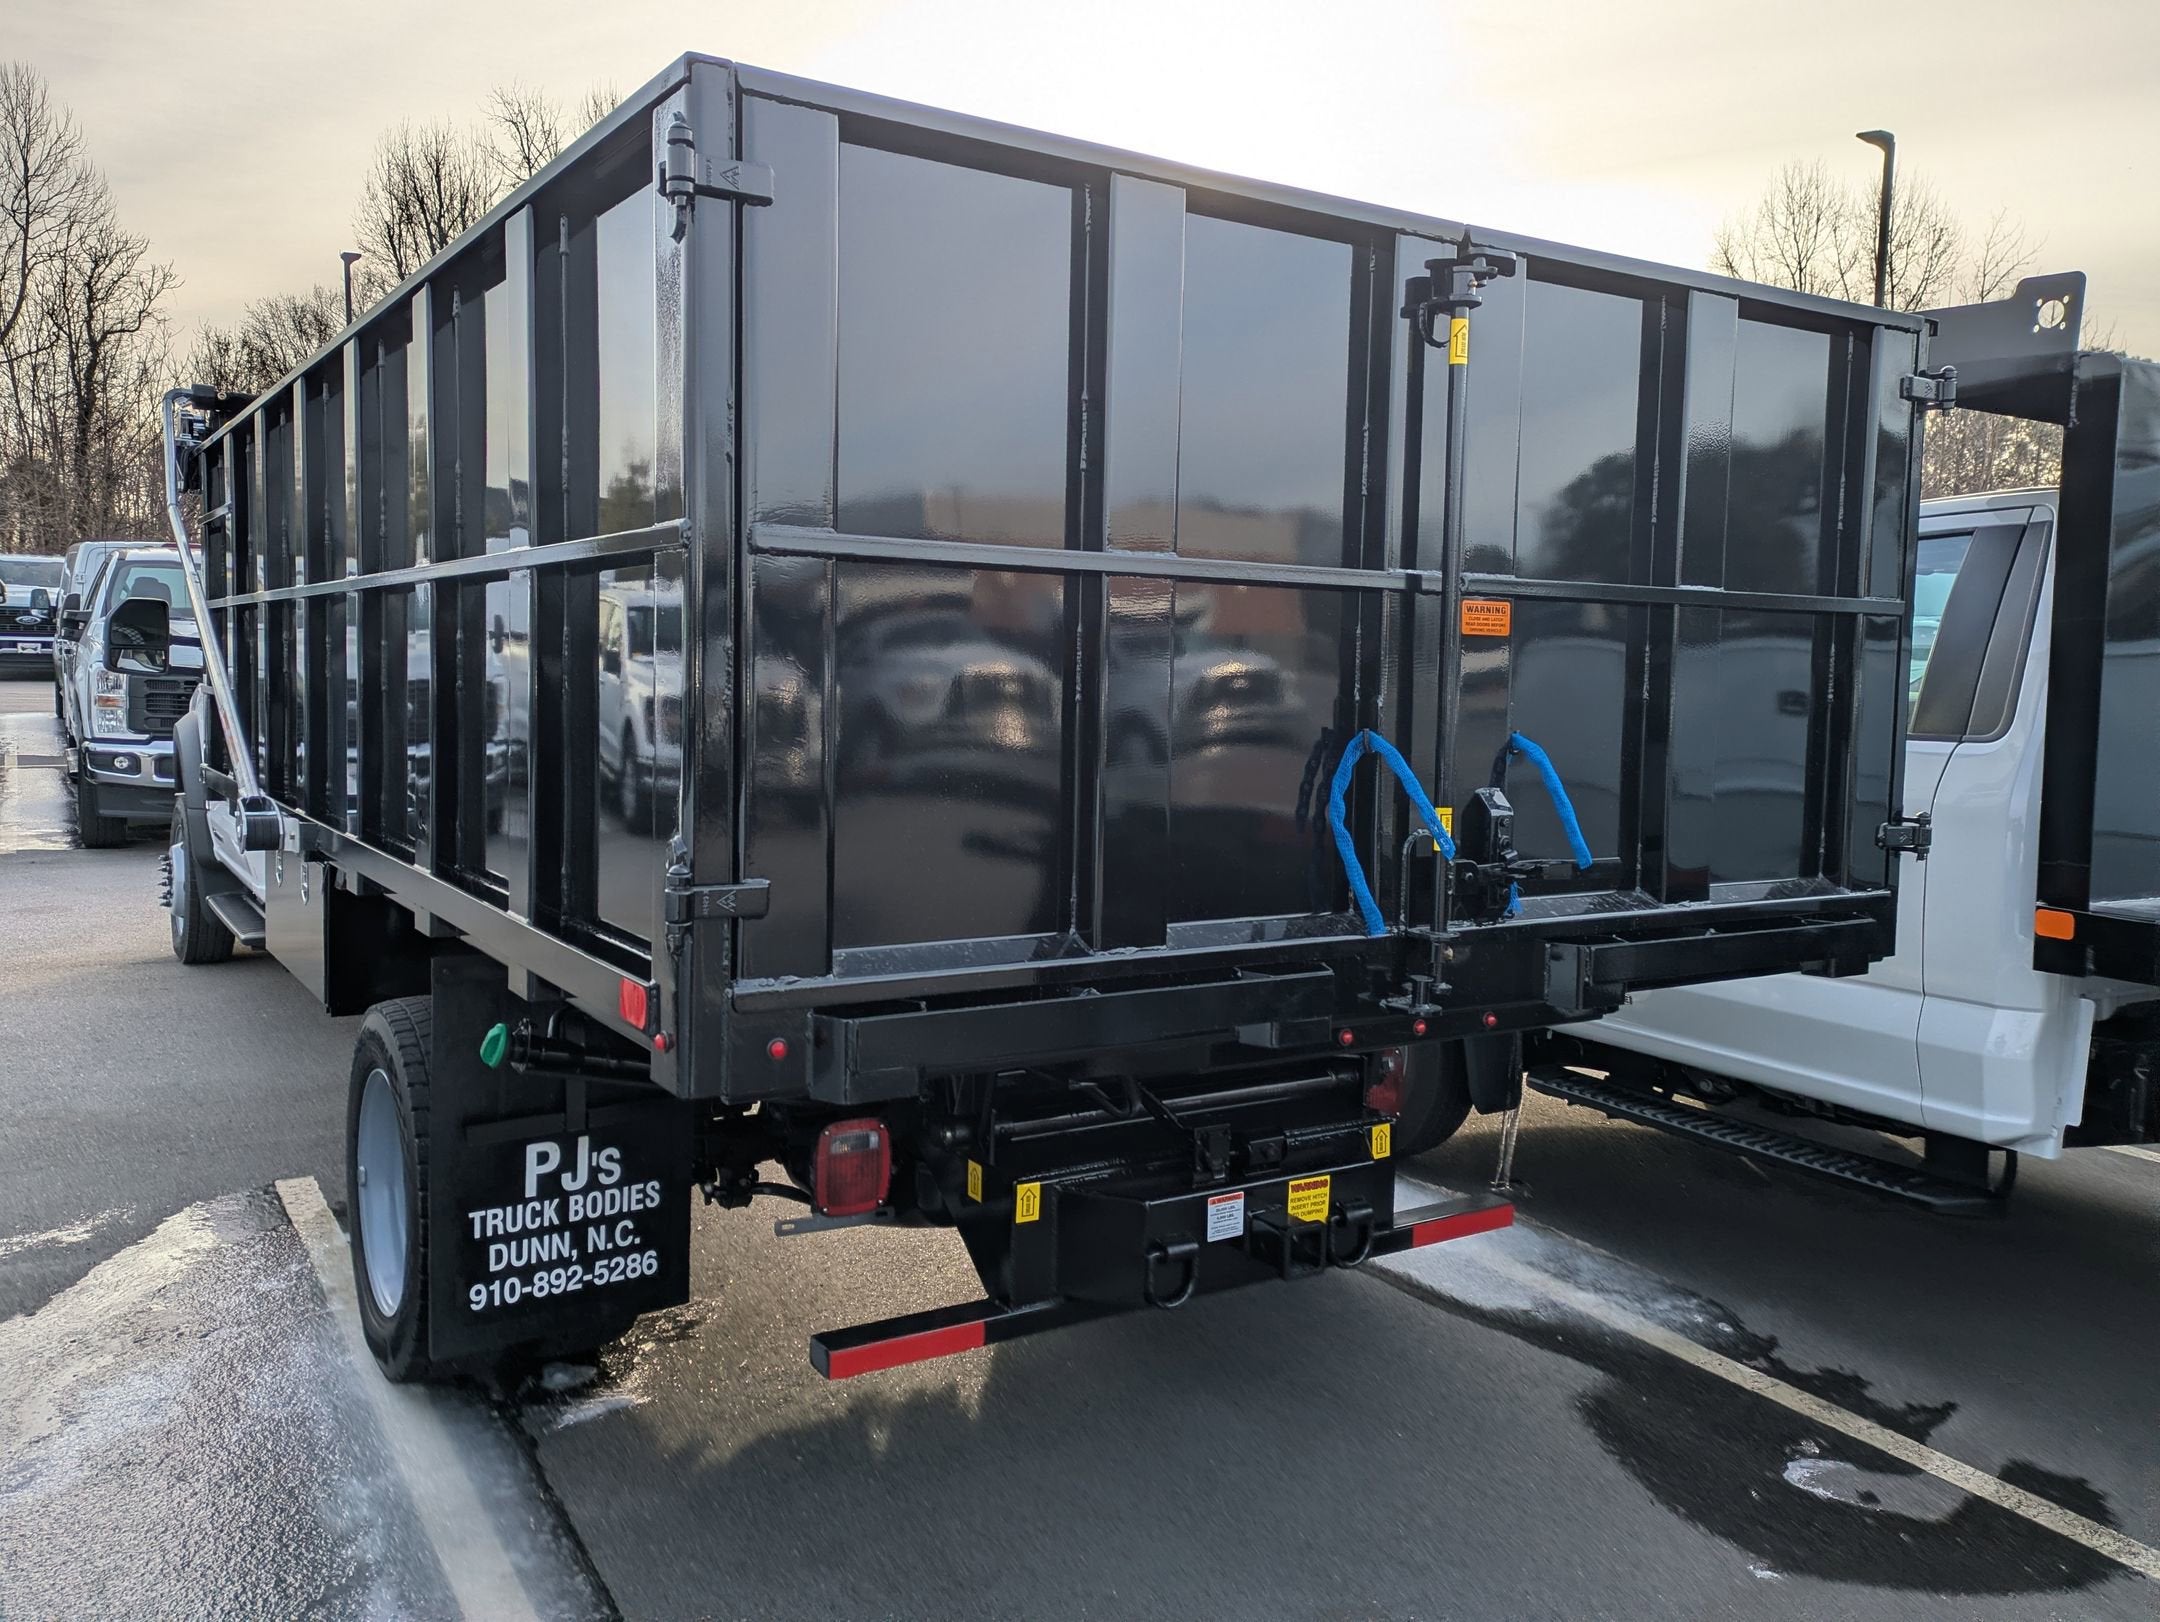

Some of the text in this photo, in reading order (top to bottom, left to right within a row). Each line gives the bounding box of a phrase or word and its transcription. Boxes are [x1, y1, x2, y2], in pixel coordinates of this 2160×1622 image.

[1466, 606, 1506, 614] WARNING
[1291, 1179, 1328, 1193] WARNING
[1290, 1192, 1328, 1203] REMOVE HITCH
[1310, 1199, 1326, 1208] PRIOR
[468, 1180, 660, 1239] TRUCK BODIES
[1301, 1208, 1324, 1217] DUMPING
[489, 1219, 641, 1272] DUNN, N.C.
[469, 1250, 658, 1311] 910-892-5286
